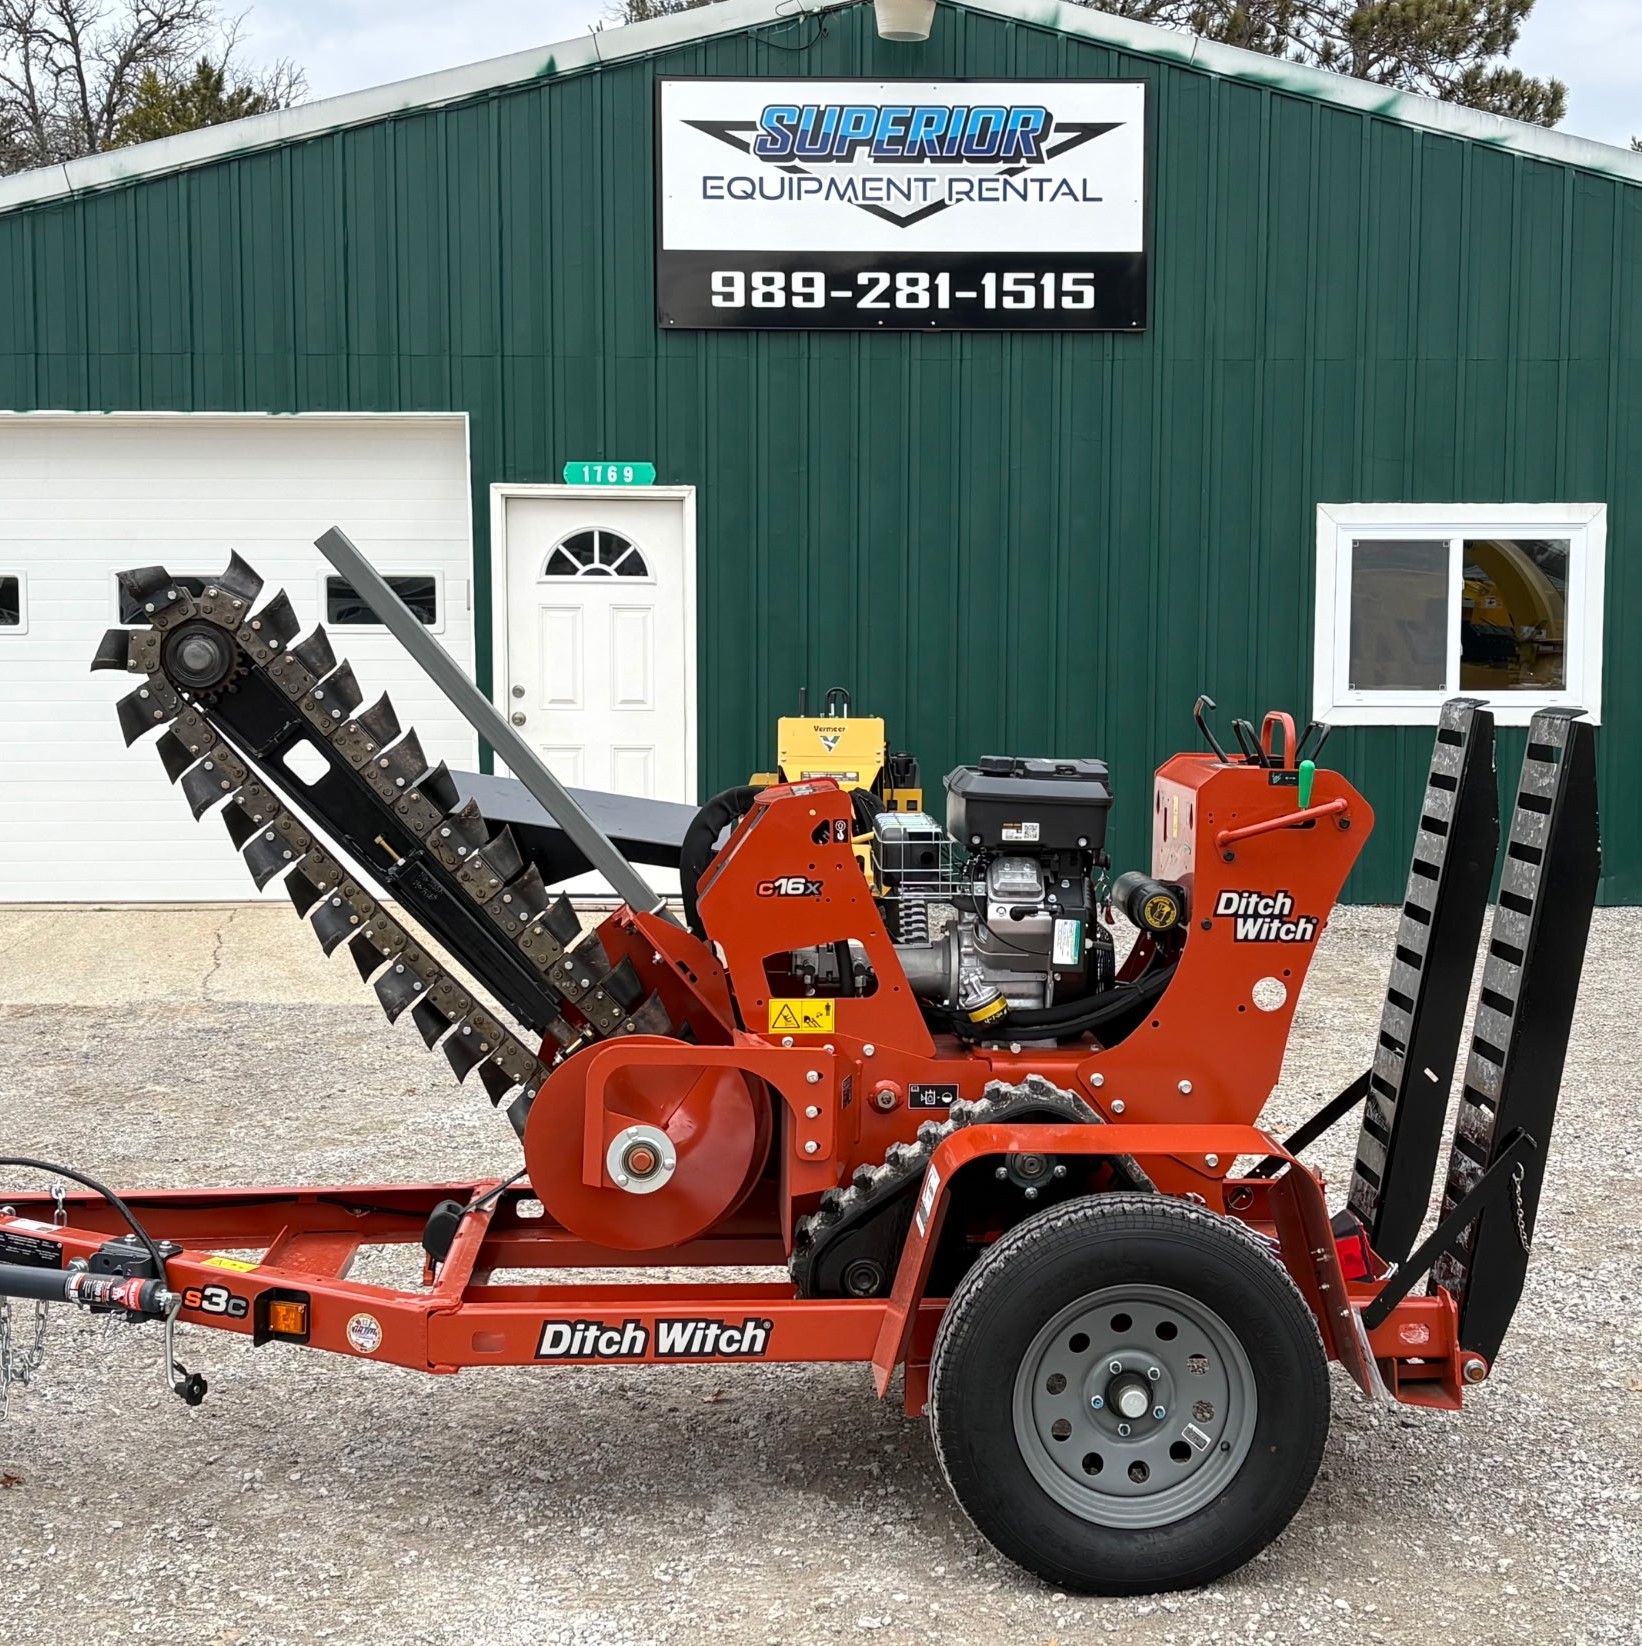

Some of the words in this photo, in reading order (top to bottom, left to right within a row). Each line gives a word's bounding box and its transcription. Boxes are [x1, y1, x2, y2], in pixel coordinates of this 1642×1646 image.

[754, 104, 1050, 162] SUPERIOR
[702, 175, 937, 204] EQUIPMENT
[952, 176, 1103, 203] RENTAL
[710, 270, 1096, 310] 989-281-1515
[582, 465, 634, 483] 1769
[813, 725, 846, 733] Vermeer
[1216, 892, 1293, 915] Ditch
[1236, 917, 1314, 941] Witch
[539, 1322, 646, 1356] Ditch
[658, 1321, 767, 1354] Witch
